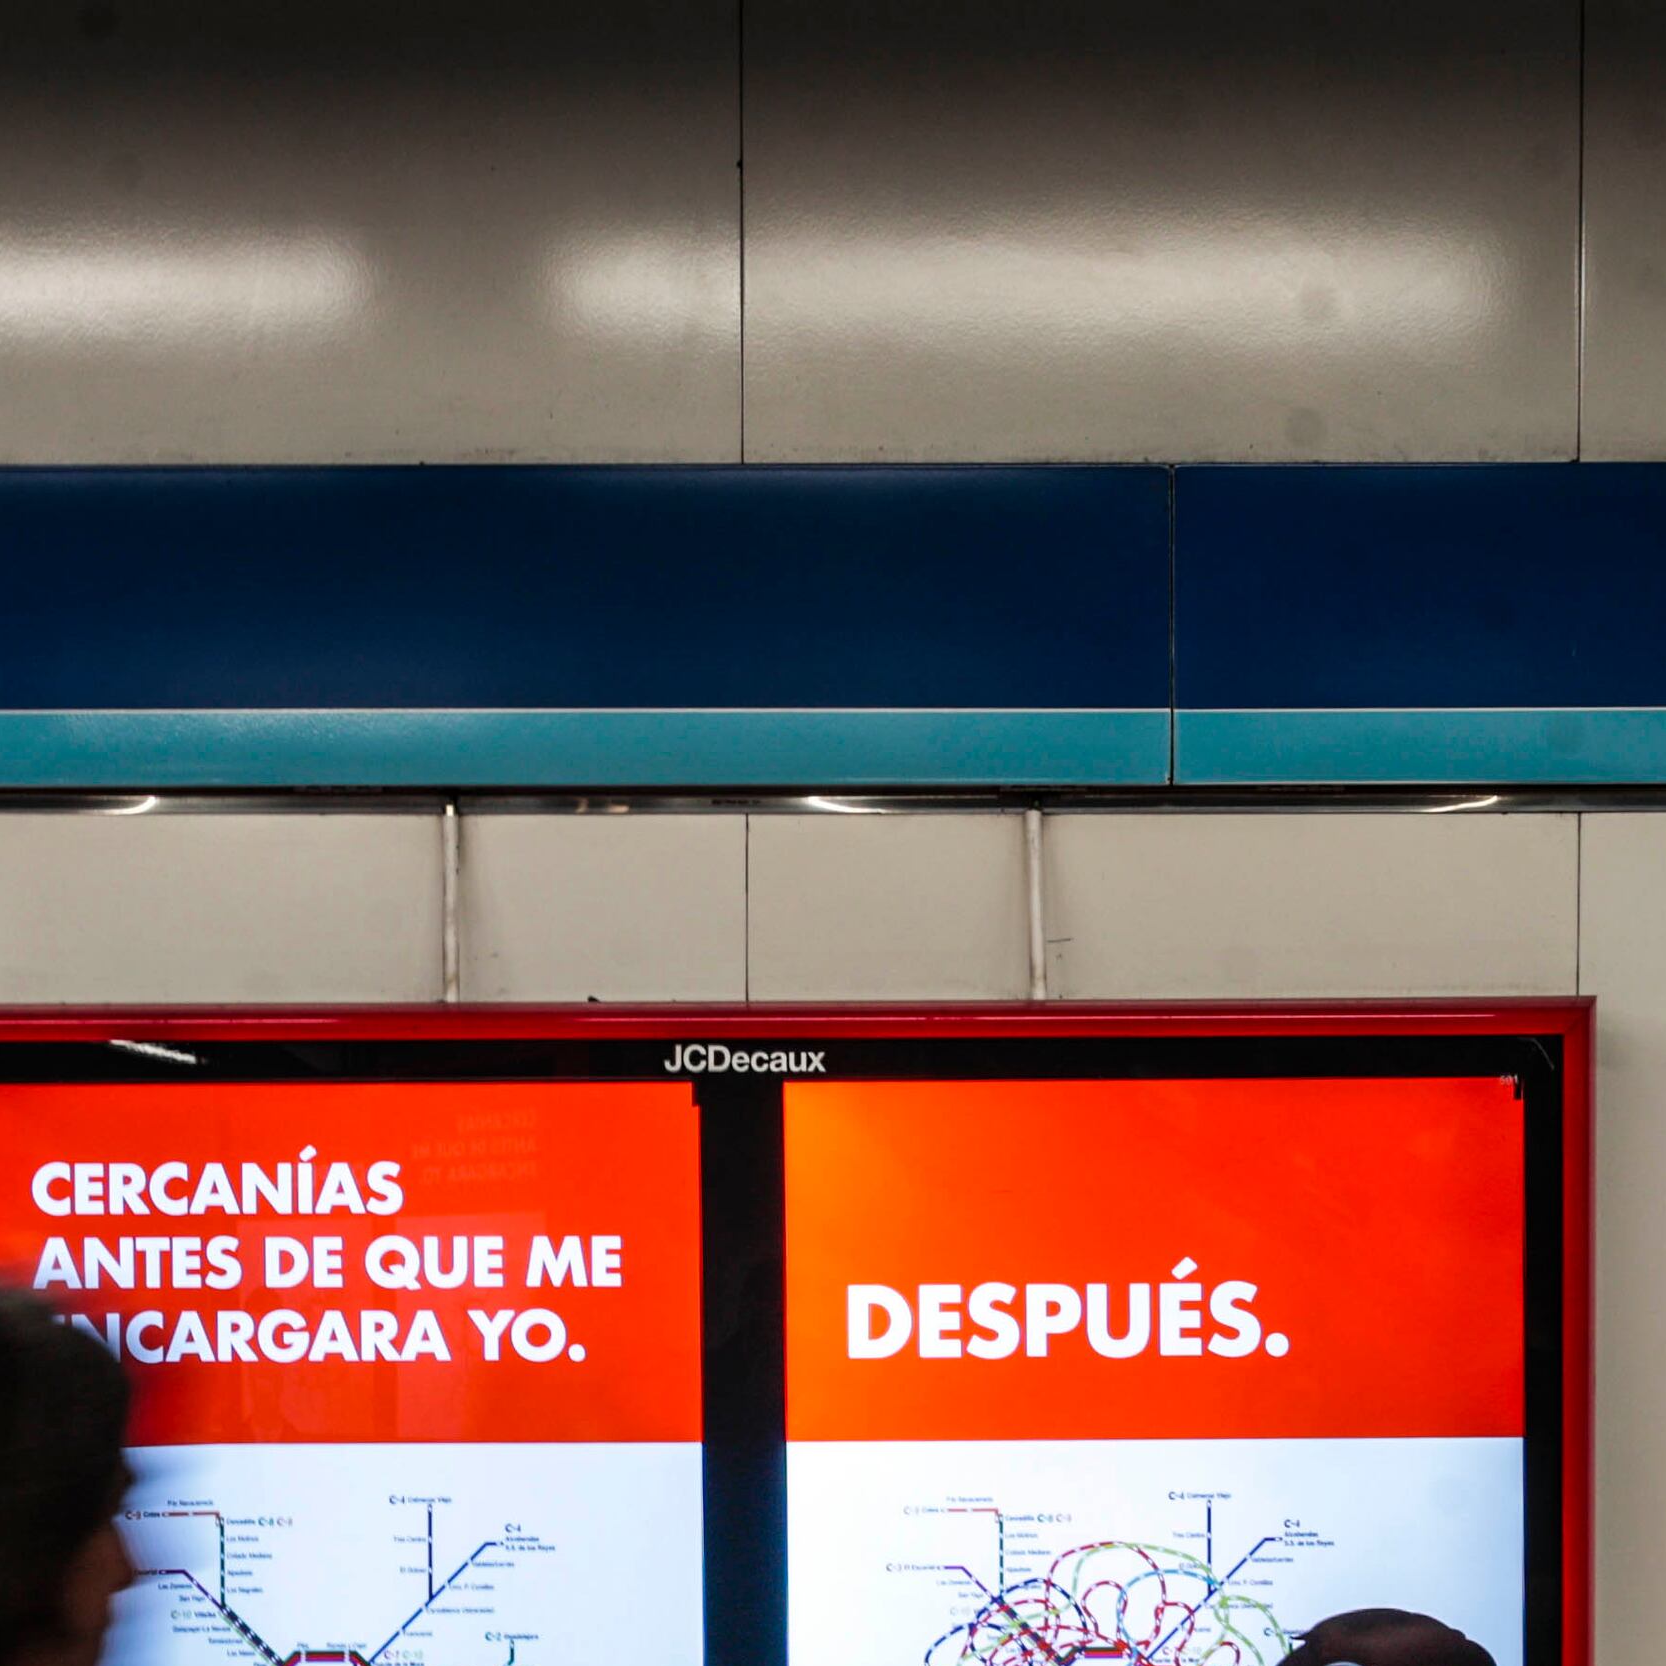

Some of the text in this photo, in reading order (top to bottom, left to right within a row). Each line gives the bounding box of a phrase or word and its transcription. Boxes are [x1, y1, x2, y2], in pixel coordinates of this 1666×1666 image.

[664, 1044, 827, 1073] JCDecaux
[32, 1144, 404, 1216] CERCANÍAS
[33, 1234, 623, 1291] ANTES DE QUE ME
[51, 1308, 586, 1364] NCARGARA YO.
[847, 1256, 1290, 1360] DESPUÉS.
